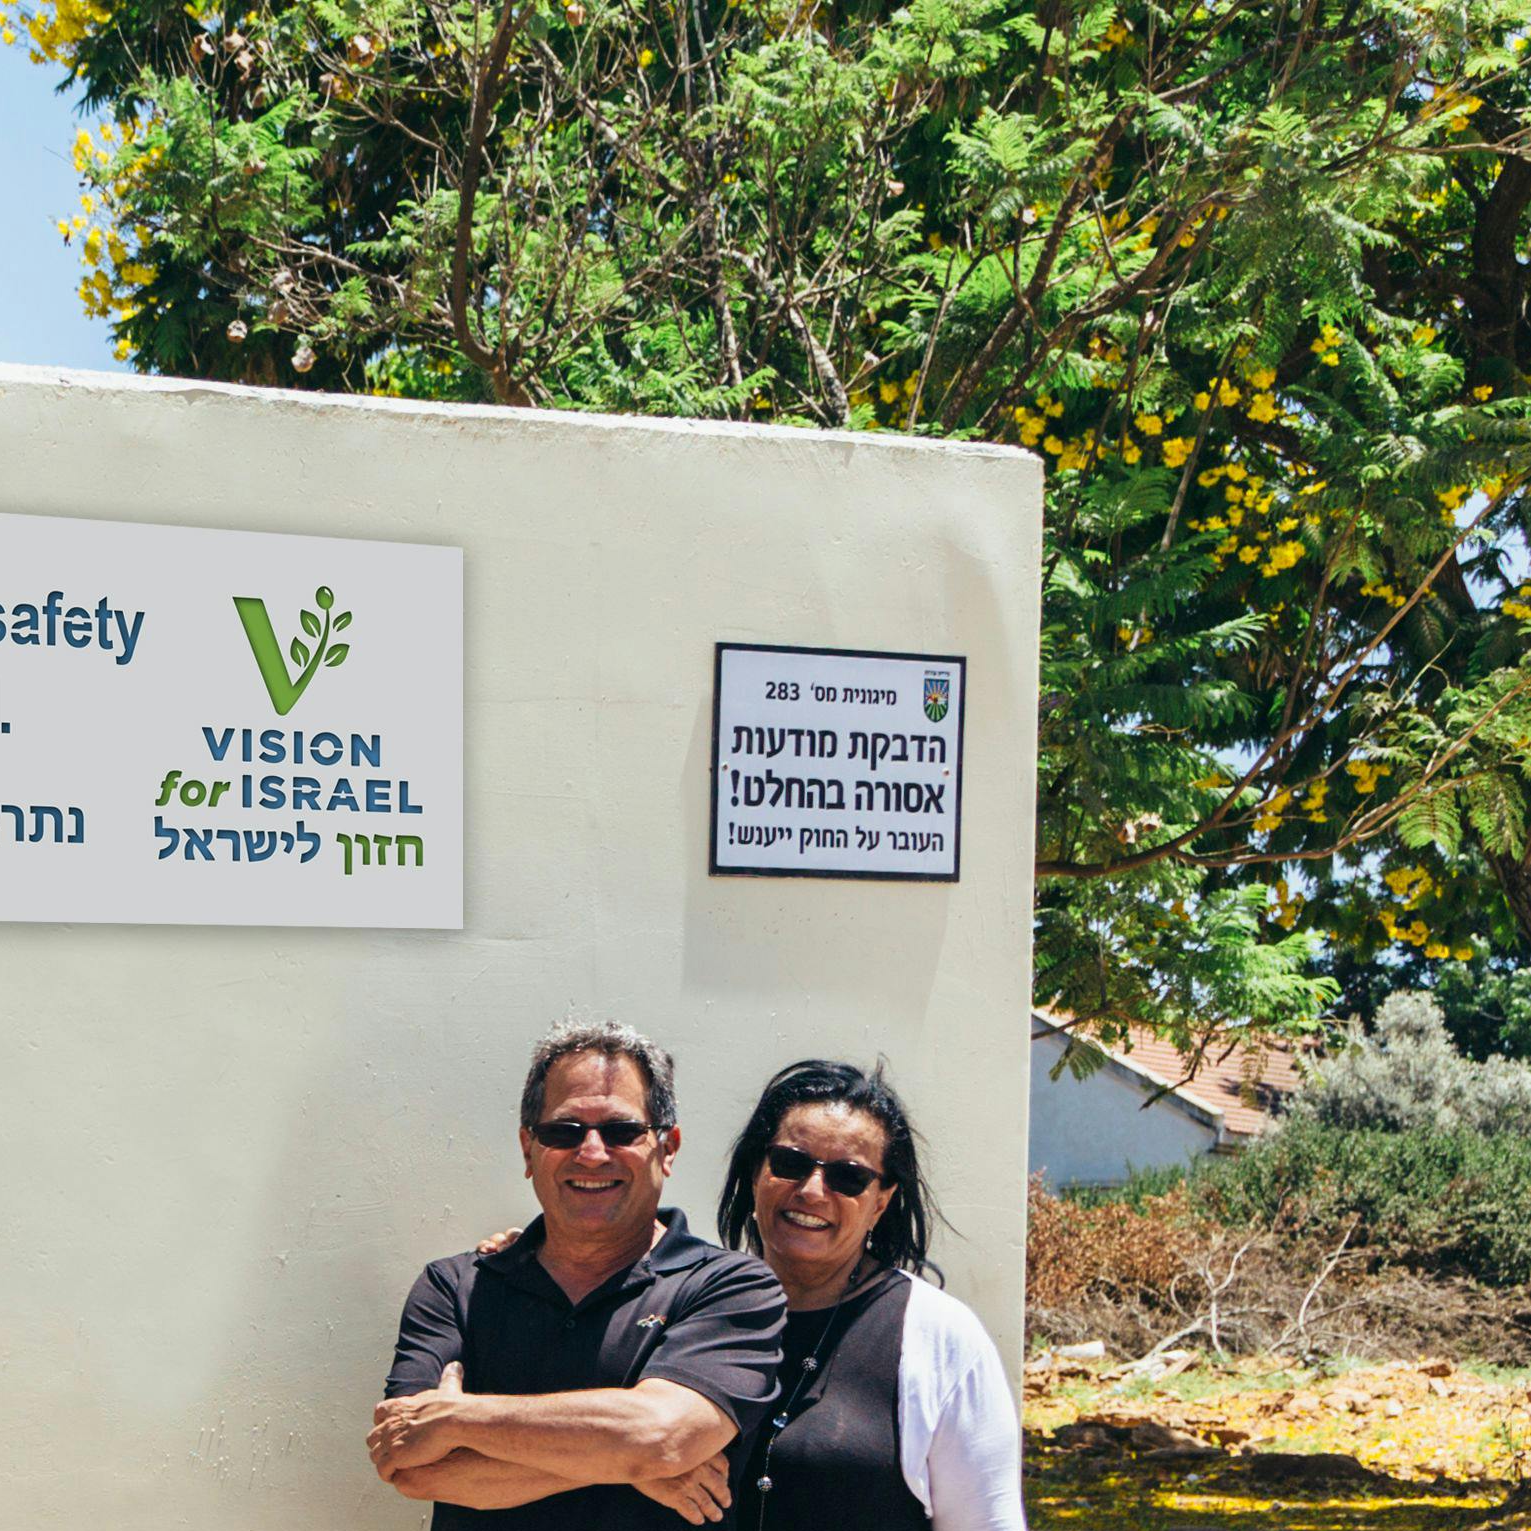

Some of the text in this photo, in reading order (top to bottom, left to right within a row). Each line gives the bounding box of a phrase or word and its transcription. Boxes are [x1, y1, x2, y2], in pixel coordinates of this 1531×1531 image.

[764, 681, 801, 702] 283
[841, 686, 898, 706] מיגונית
[200, 727, 382, 768] VISION
[730, 725, 947, 771] הדבקת מודעות
[154, 769, 424, 815] for ISRAEL
[730, 769, 946, 815] אסורה בהחלט!
[154, 815, 425, 876] חזון לישראל
[728, 820, 945, 855] העובר על החוק ייענש!
